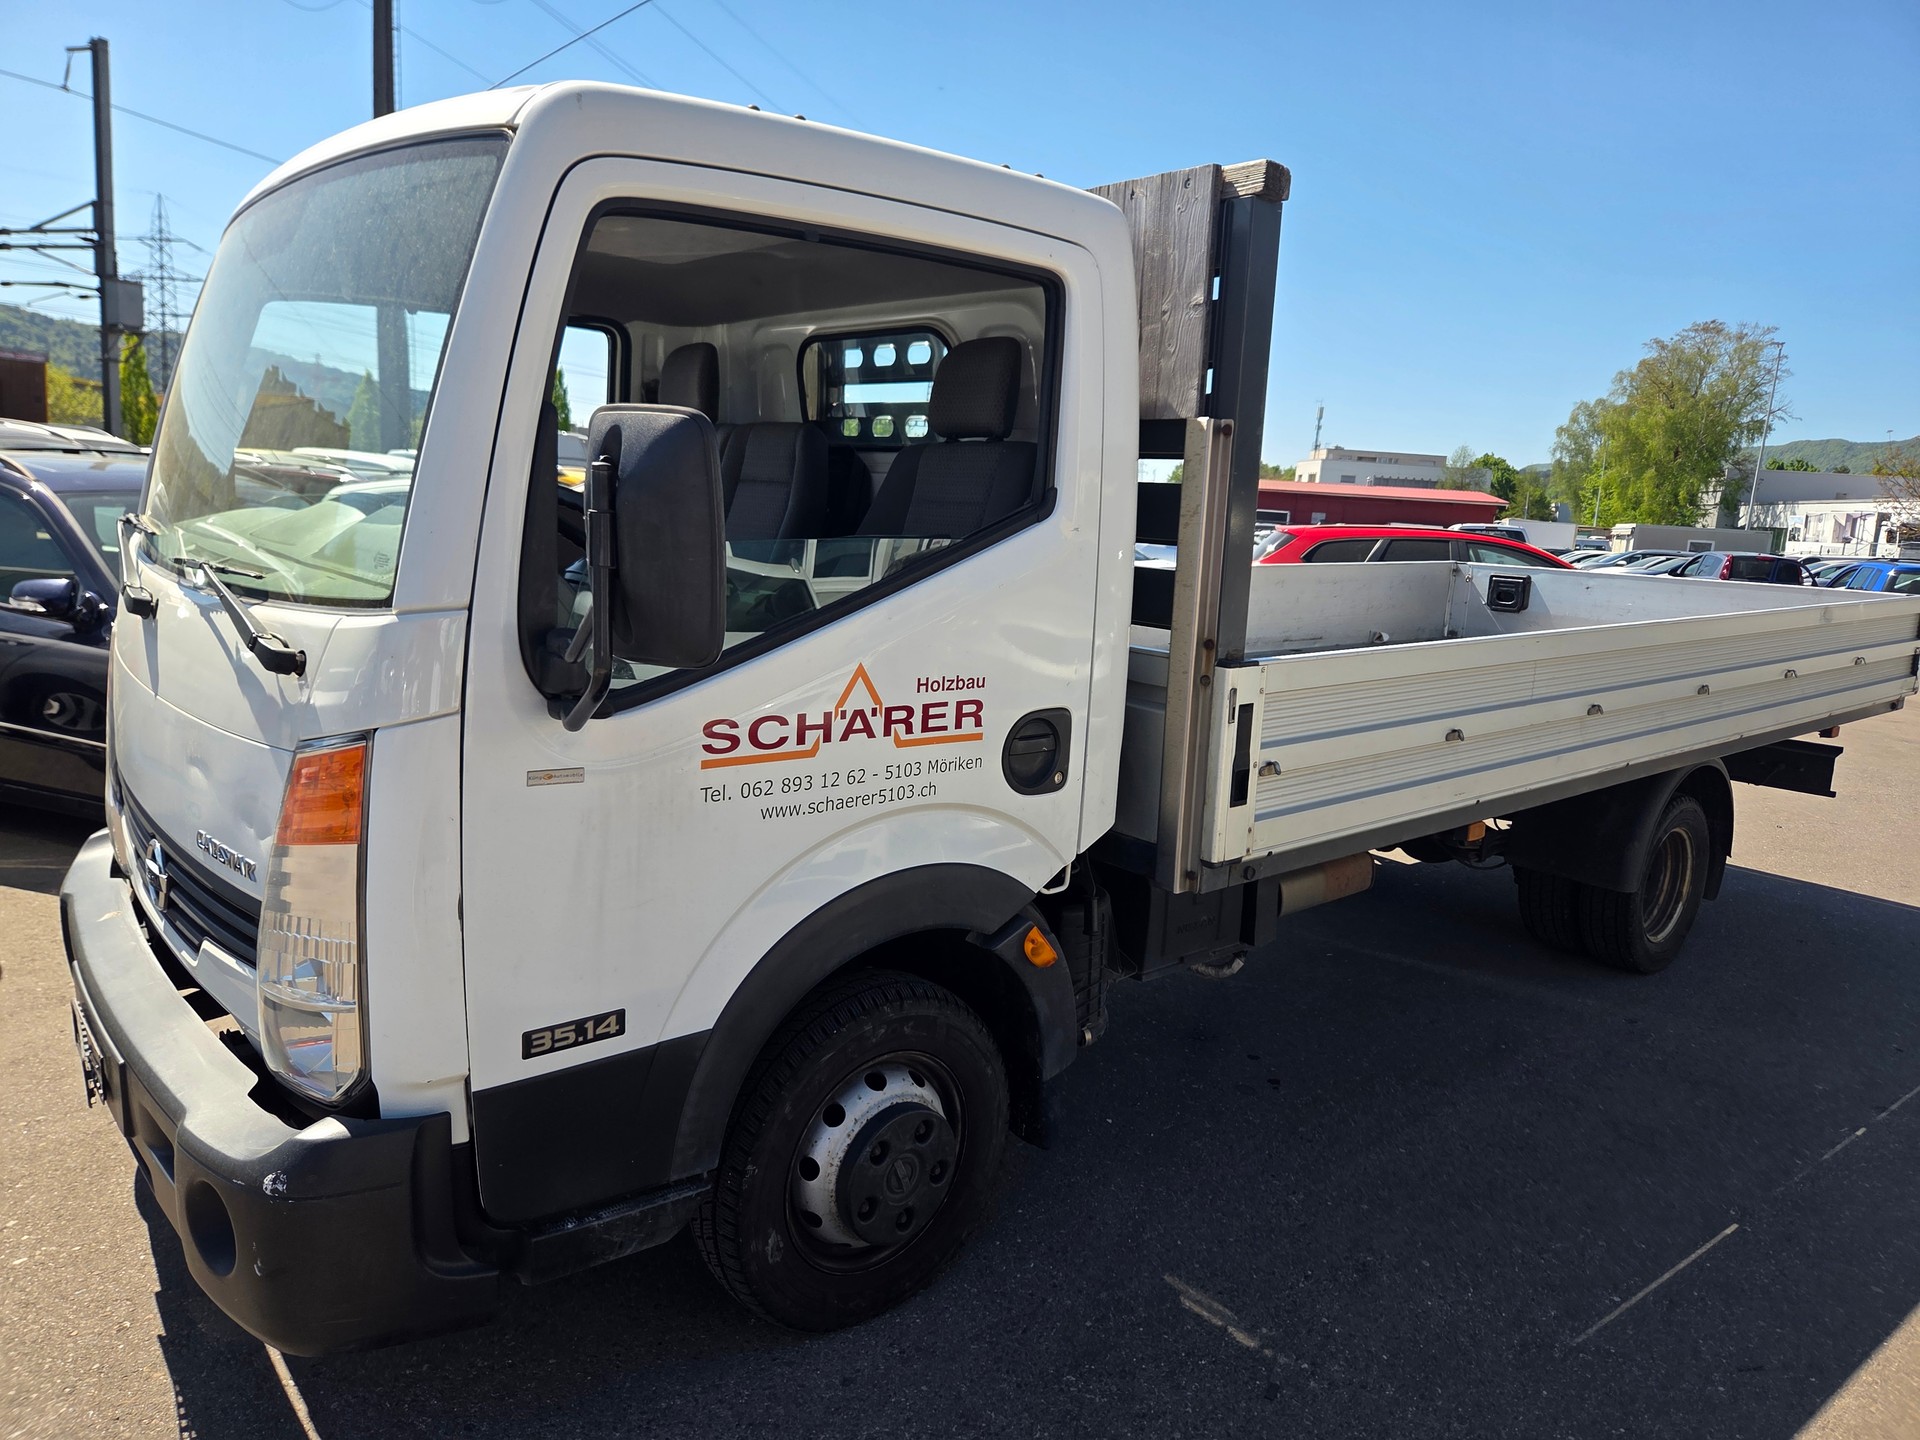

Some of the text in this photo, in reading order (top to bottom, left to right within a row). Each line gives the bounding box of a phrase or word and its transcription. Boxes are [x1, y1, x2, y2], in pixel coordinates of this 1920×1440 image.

[916, 675, 986, 694] Holzbau
[701, 699, 984, 755] SCHÄRER
[700, 784, 732, 803] Tel.
[740, 780, 774, 799] 062
[781, 775, 813, 794] 893
[821, 771, 840, 789] 12
[846, 768, 866, 785] 62
[885, 761, 922, 780] 5103
[927, 755, 983, 776] Möriken
[760, 781, 937, 820] www.schaerer5103.ch
[530, 1014, 620, 1054] 35.14
